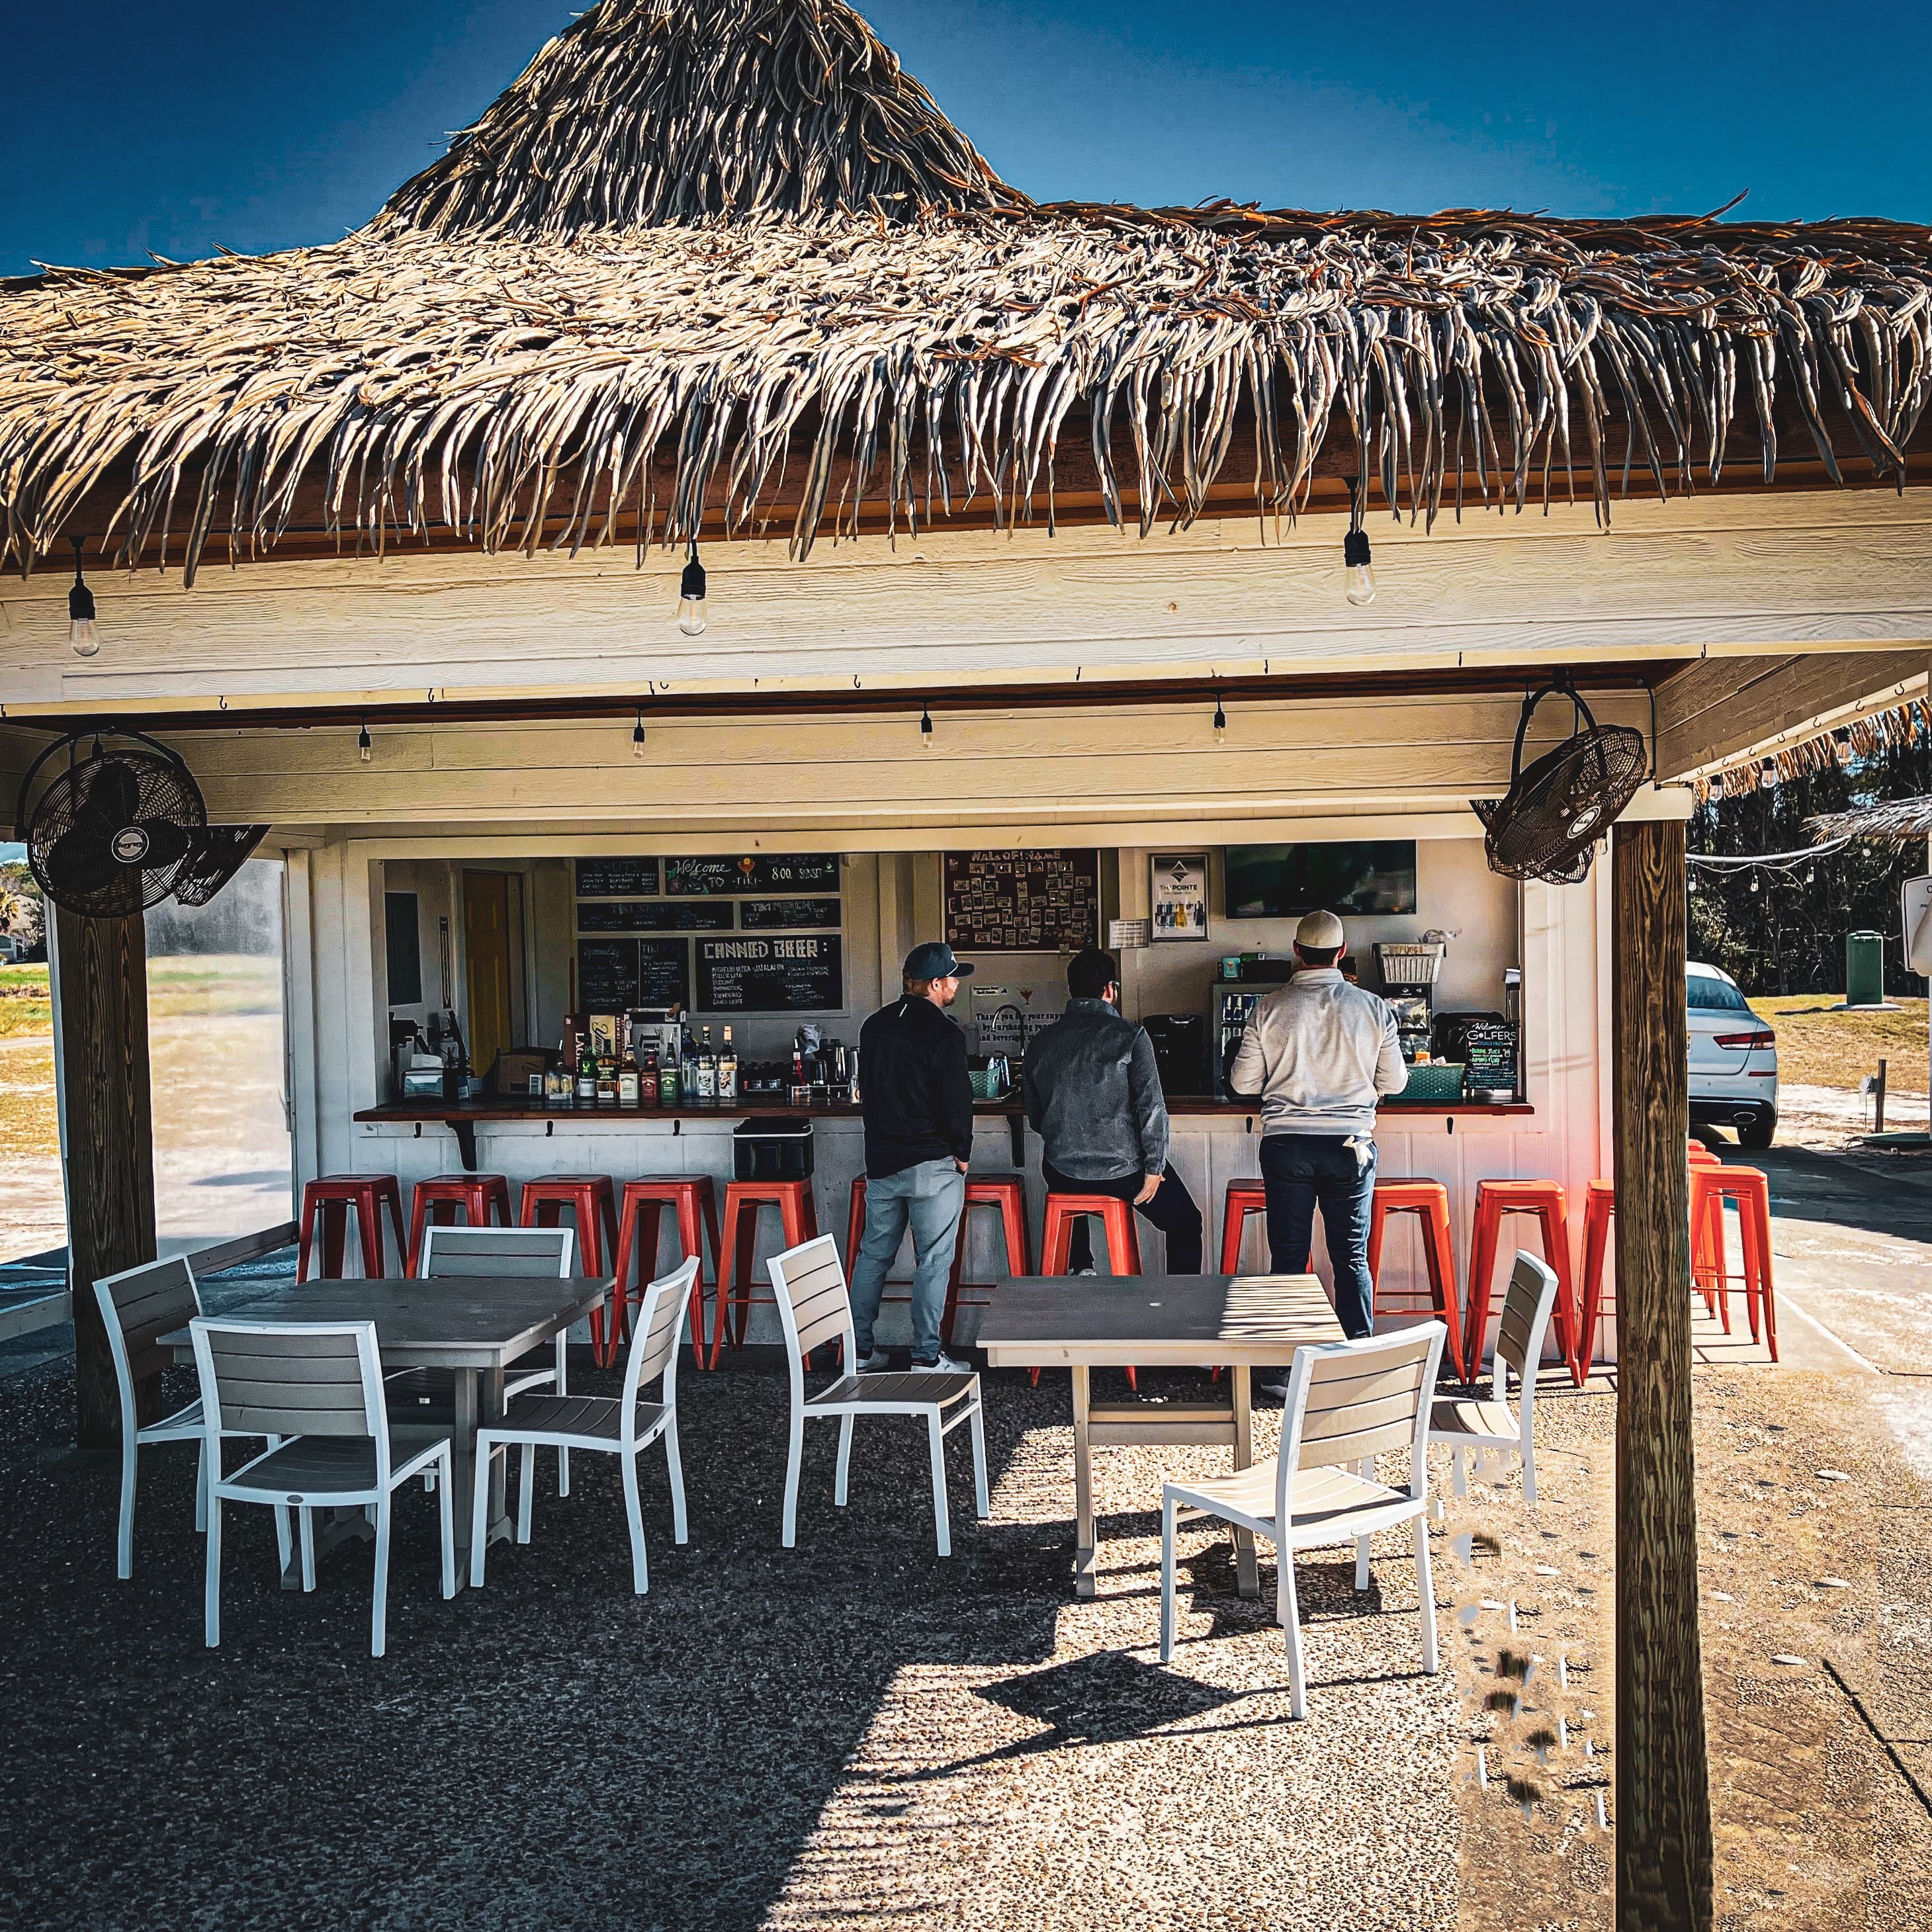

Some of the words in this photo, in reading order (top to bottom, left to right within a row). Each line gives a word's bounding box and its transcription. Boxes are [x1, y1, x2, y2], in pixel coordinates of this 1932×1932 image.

[1002, 851, 1018, 860] OF
[675, 859, 732, 875] Welcome
[708, 877, 725, 887] TO
[704, 942, 769, 959] CANNED
[982, 1024, 991, 1032] by
[1466, 1030, 1517, 1041] GOLFERS
